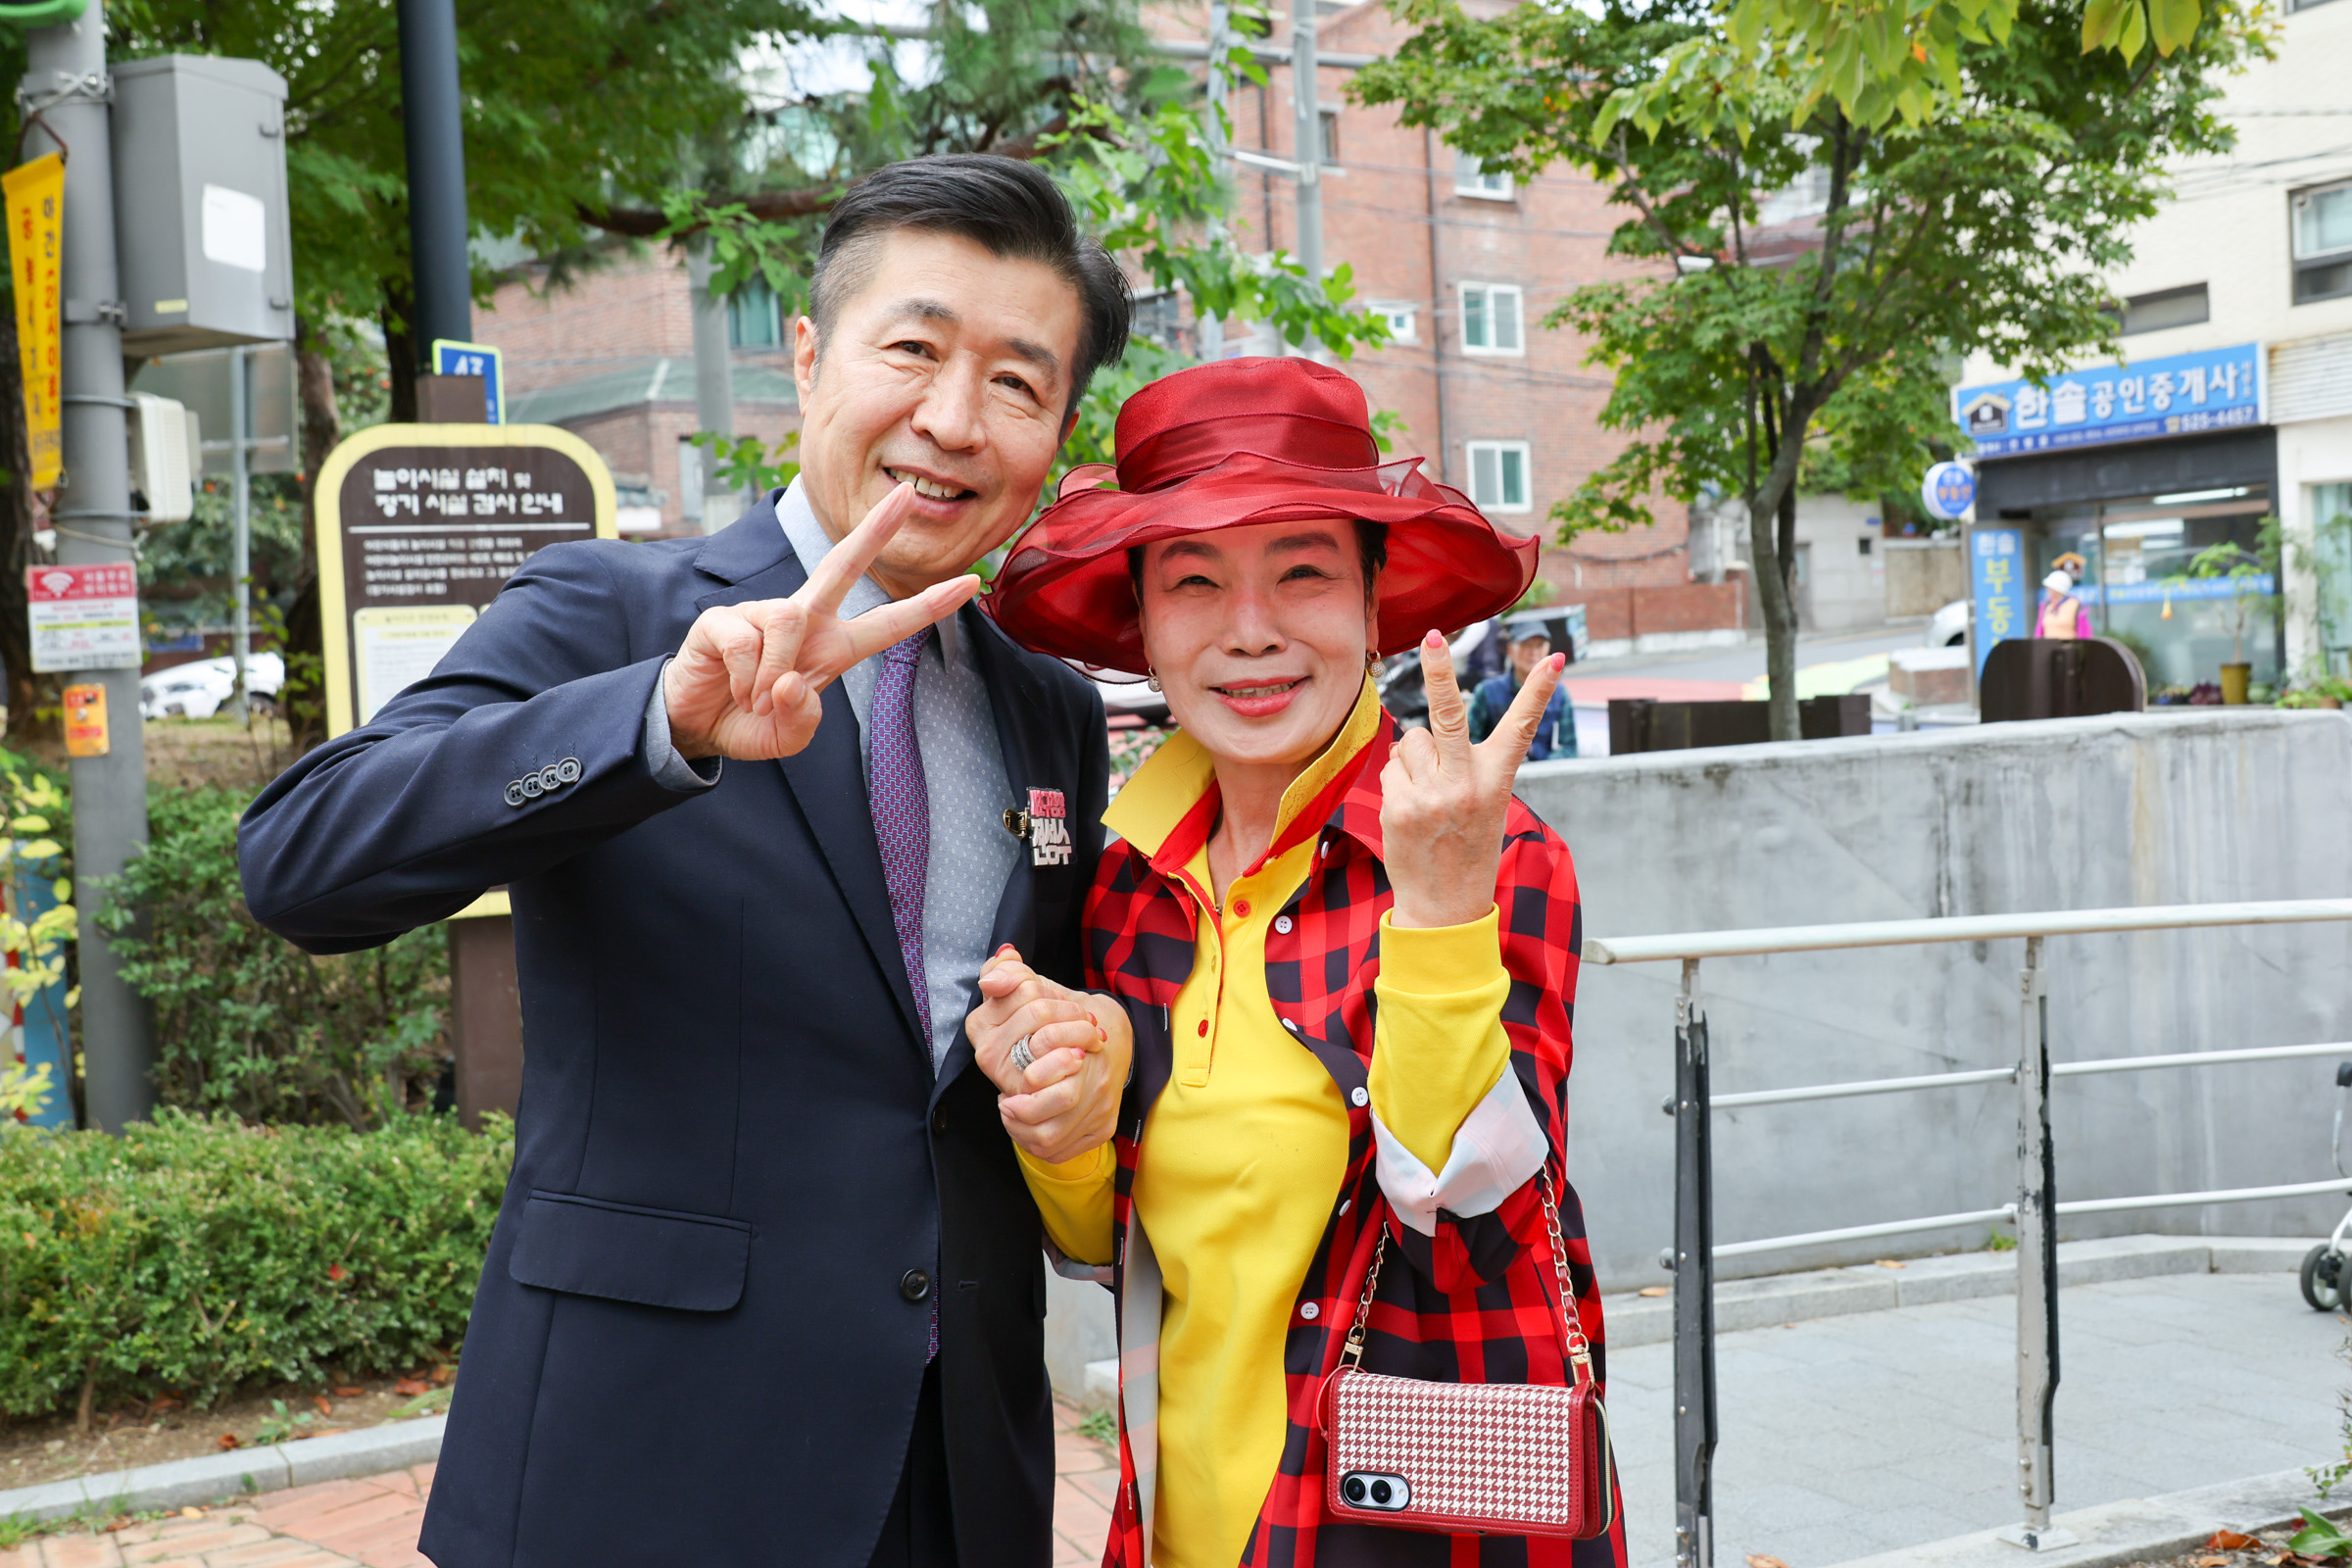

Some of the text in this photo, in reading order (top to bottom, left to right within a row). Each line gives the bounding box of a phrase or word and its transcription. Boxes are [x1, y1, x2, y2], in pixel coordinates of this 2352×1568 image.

[373, 467, 461, 491] 놀이시설
[465, 466, 509, 490] 설치
[374, 493, 420, 517] 정기
[424, 493, 469, 516] 시설
[519, 492, 564, 515] 안내
[1984, 558, 2014, 647] 부동
